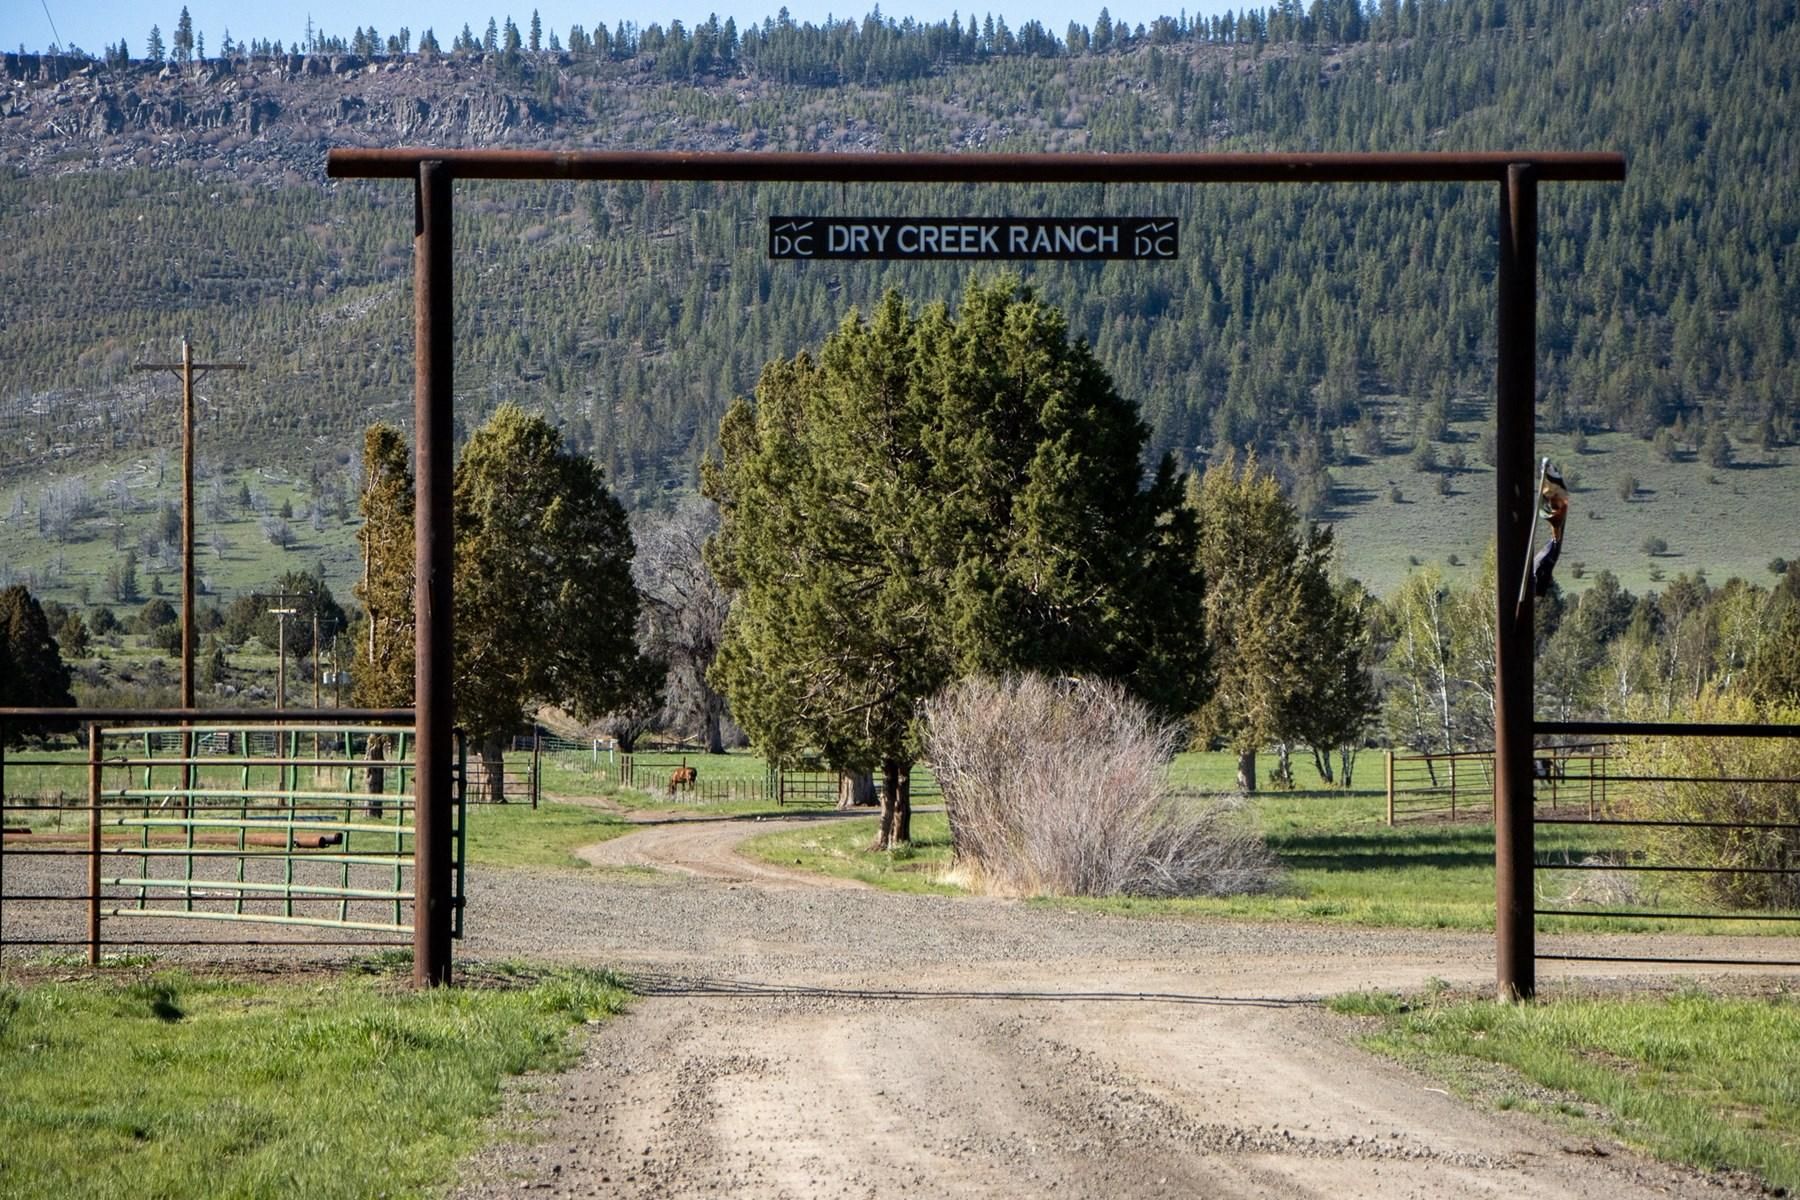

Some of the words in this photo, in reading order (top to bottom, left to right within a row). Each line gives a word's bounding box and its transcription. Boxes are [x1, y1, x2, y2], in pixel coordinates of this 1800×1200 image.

[774, 235, 813, 256] DC
[828, 225, 891, 252] DRY
[897, 225, 999, 253] CREEK
[1009, 225, 1118, 252] RANCH
[1135, 236, 1174, 256] DC
